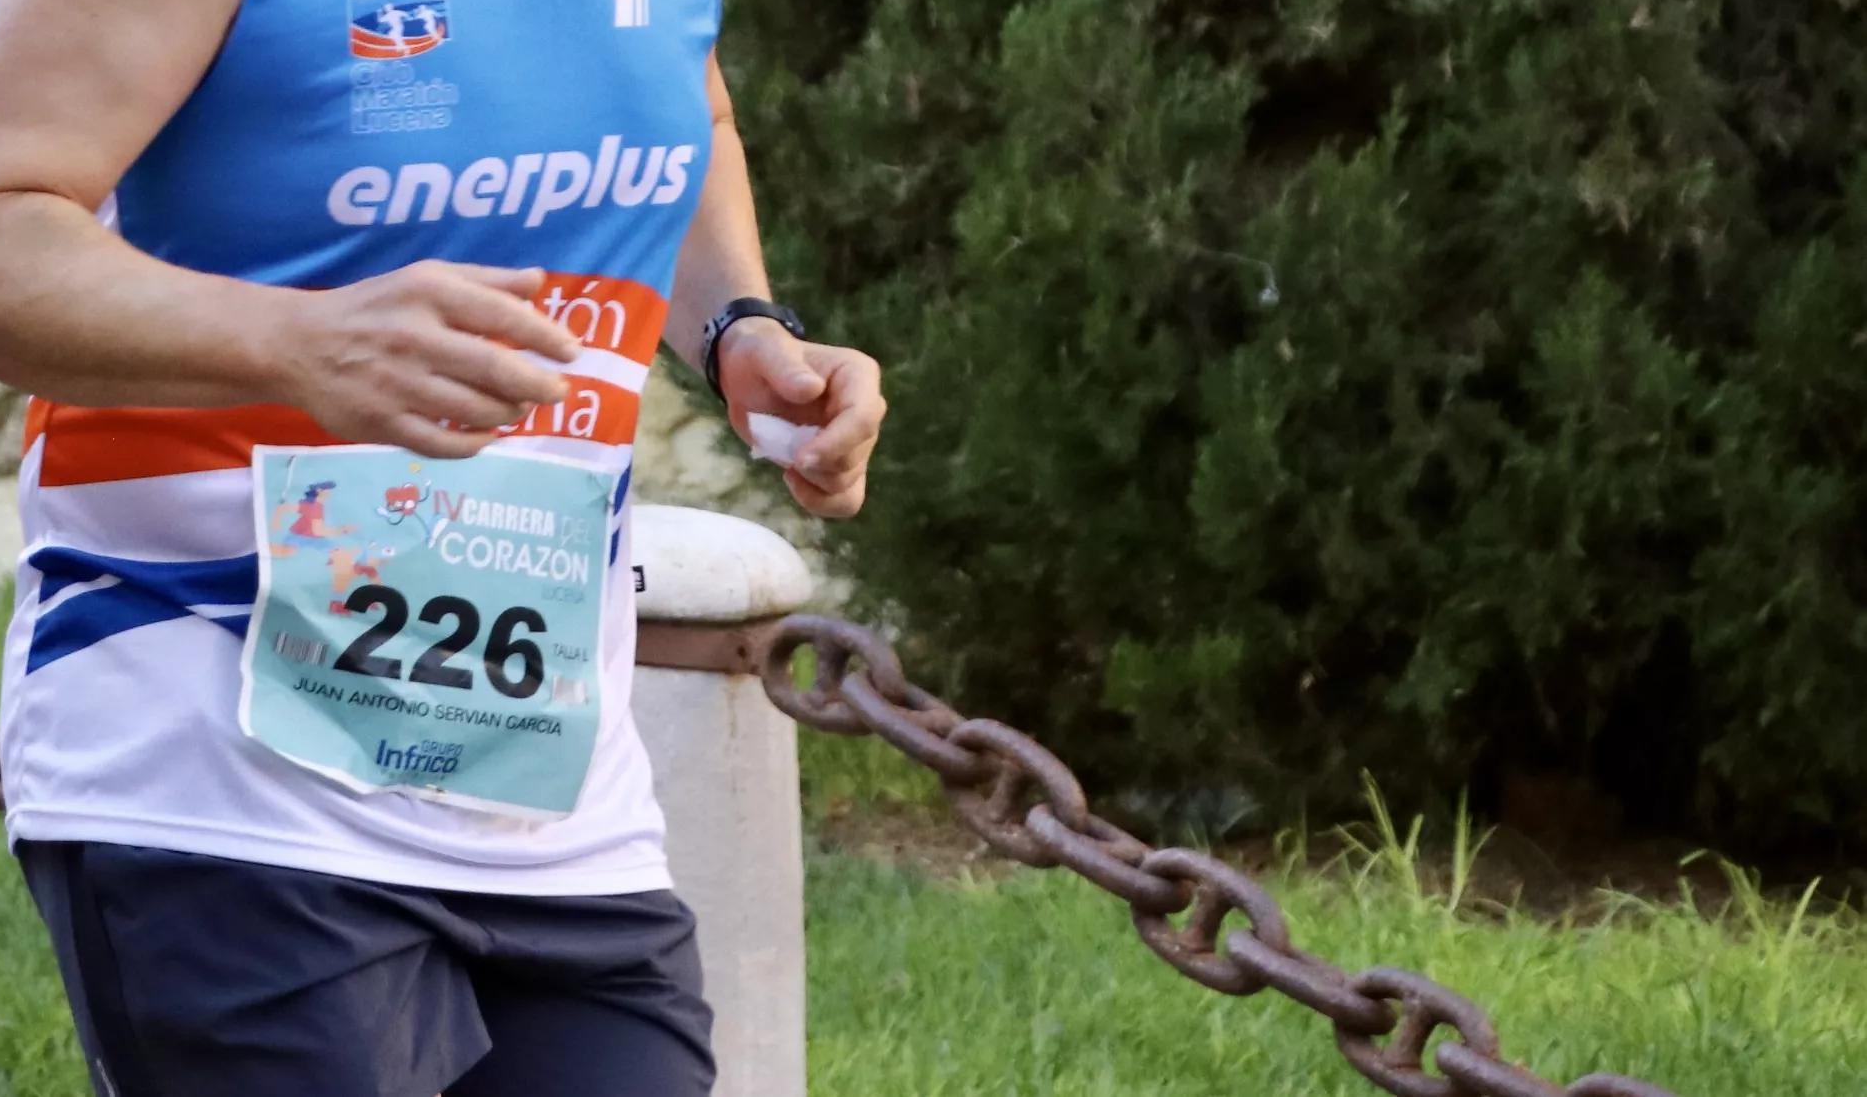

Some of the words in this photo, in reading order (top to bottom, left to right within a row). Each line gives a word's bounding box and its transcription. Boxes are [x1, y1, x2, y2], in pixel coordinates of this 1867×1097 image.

[327, 135, 696, 228] enerplus
[462, 498, 555, 537] CARRERA
[333, 585, 547, 699] 226
[293, 678, 344, 701] JUAN
[348, 690, 430, 717] ANTONIO
[435, 705, 503, 727] SERVIAN
[506, 715, 562, 736] GARCIA
[376, 739, 459, 773] Infrico
[421, 739, 464, 757] GRUPO
